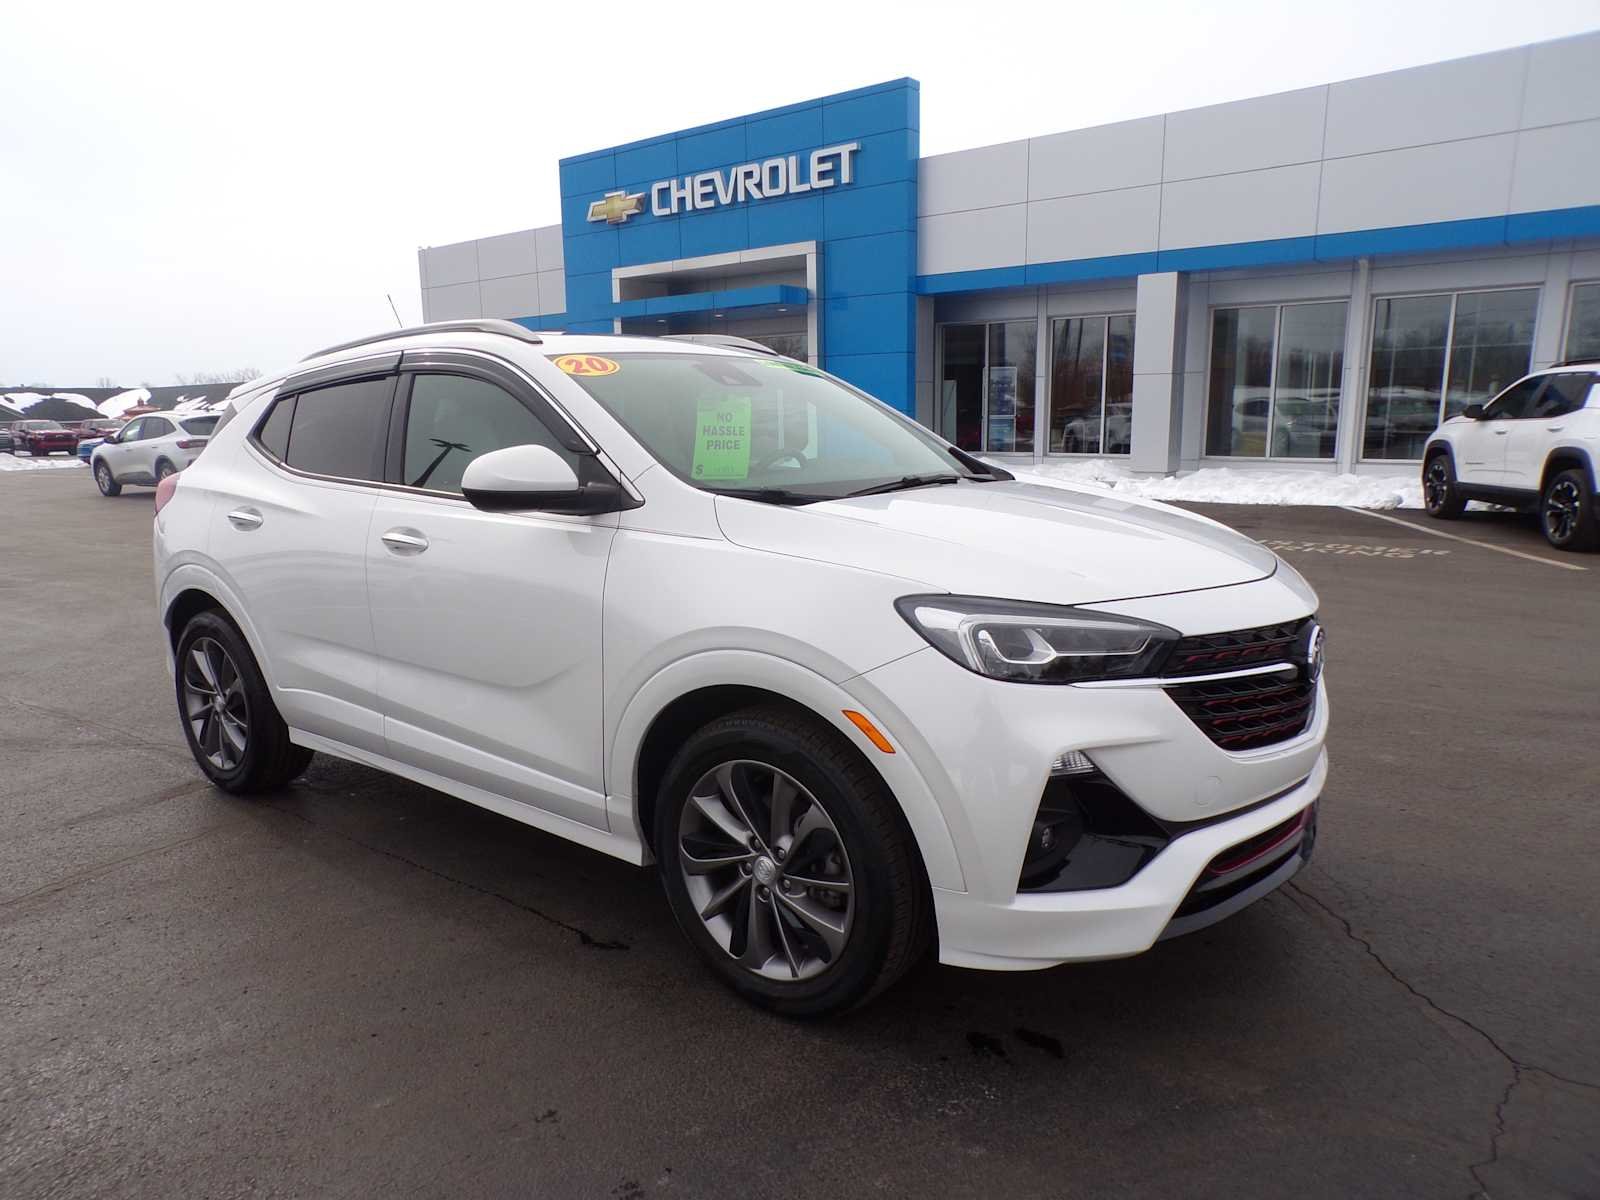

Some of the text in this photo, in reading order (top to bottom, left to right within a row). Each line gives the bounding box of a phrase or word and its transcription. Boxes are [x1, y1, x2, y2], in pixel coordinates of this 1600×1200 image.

[651, 142, 860, 216] CHEVROLET
[567, 357, 609, 373] 20
[717, 412, 733, 423] NO
[703, 425, 745, 437] HASSLE
[706, 439, 741, 451] PRICE
